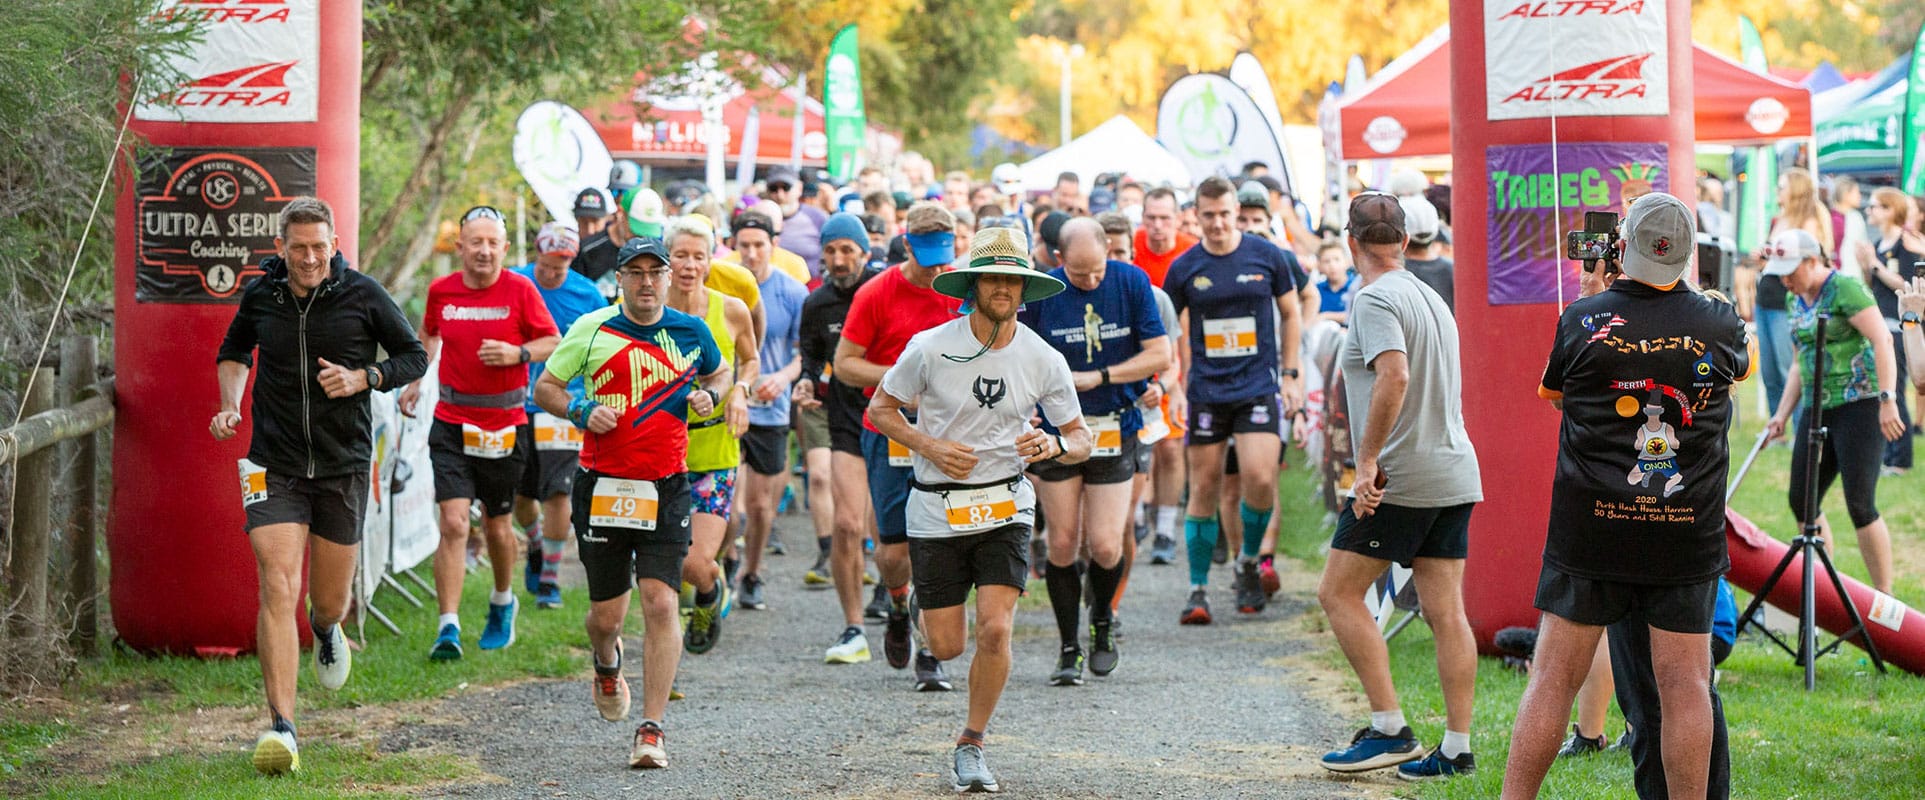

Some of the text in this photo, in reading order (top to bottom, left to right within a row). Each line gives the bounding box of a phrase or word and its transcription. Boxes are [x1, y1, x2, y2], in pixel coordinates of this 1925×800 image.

[1498, 0, 1645, 20] ALTRA
[1501, 83, 1647, 104] ALTRA
[145, 212, 221, 236] ULTRA
[190, 240, 250, 265] Coaching
[1618, 380, 1646, 390] PERTH
[479, 430, 504, 449] 125
[1643, 460, 1673, 471] ONON
[611, 497, 637, 518] 49
[1596, 500, 1694, 513] Perth Hash House Harriers
[1635, 496, 1657, 504] 2020
[969, 504, 996, 524] 82
[1594, 508, 1605, 517] 50
[1607, 510, 1630, 519] Years
[1649, 513, 1666, 522] Still
[1668, 514, 1695, 524] Running
